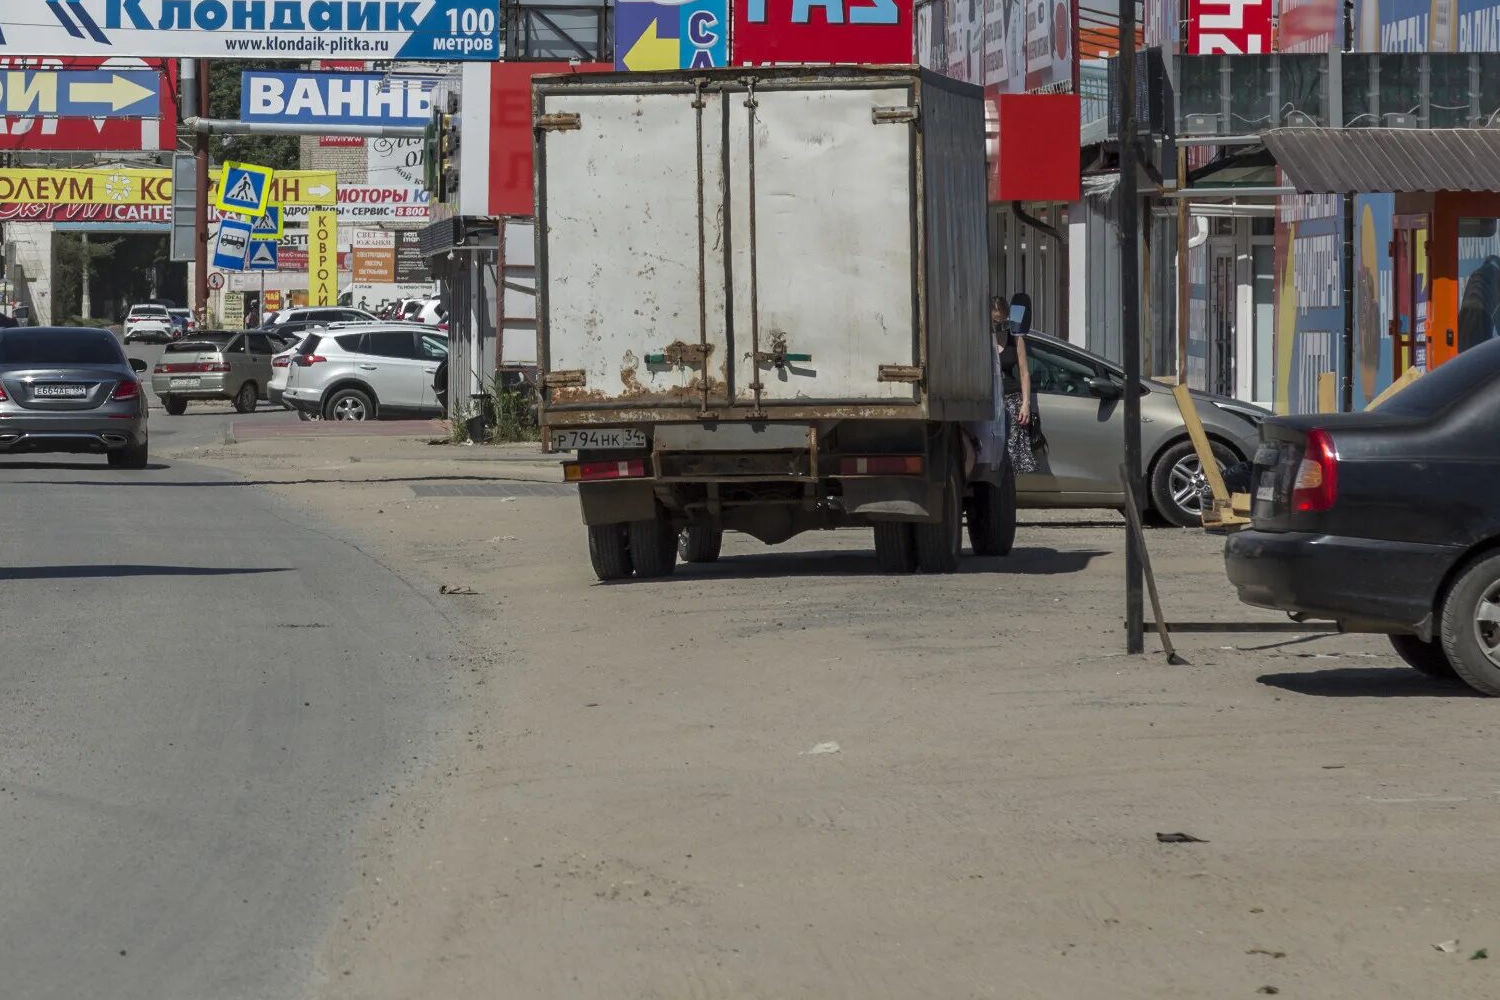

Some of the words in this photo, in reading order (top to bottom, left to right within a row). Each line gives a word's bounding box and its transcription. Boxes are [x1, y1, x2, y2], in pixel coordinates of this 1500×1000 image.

[445, 8, 495, 37] 100
[225, 35, 390, 56] www.klondaik-plitka.ru
[433, 37, 494, 56] метров
[337, 188, 409, 203] МОТОРЫ
[352, 207, 390, 215] СЕРВИС
[397, 207, 403, 215] 8
[404, 207, 424, 215] 800
[558, 432, 620, 446] Р794НК
[625, 429, 641, 441] 34
